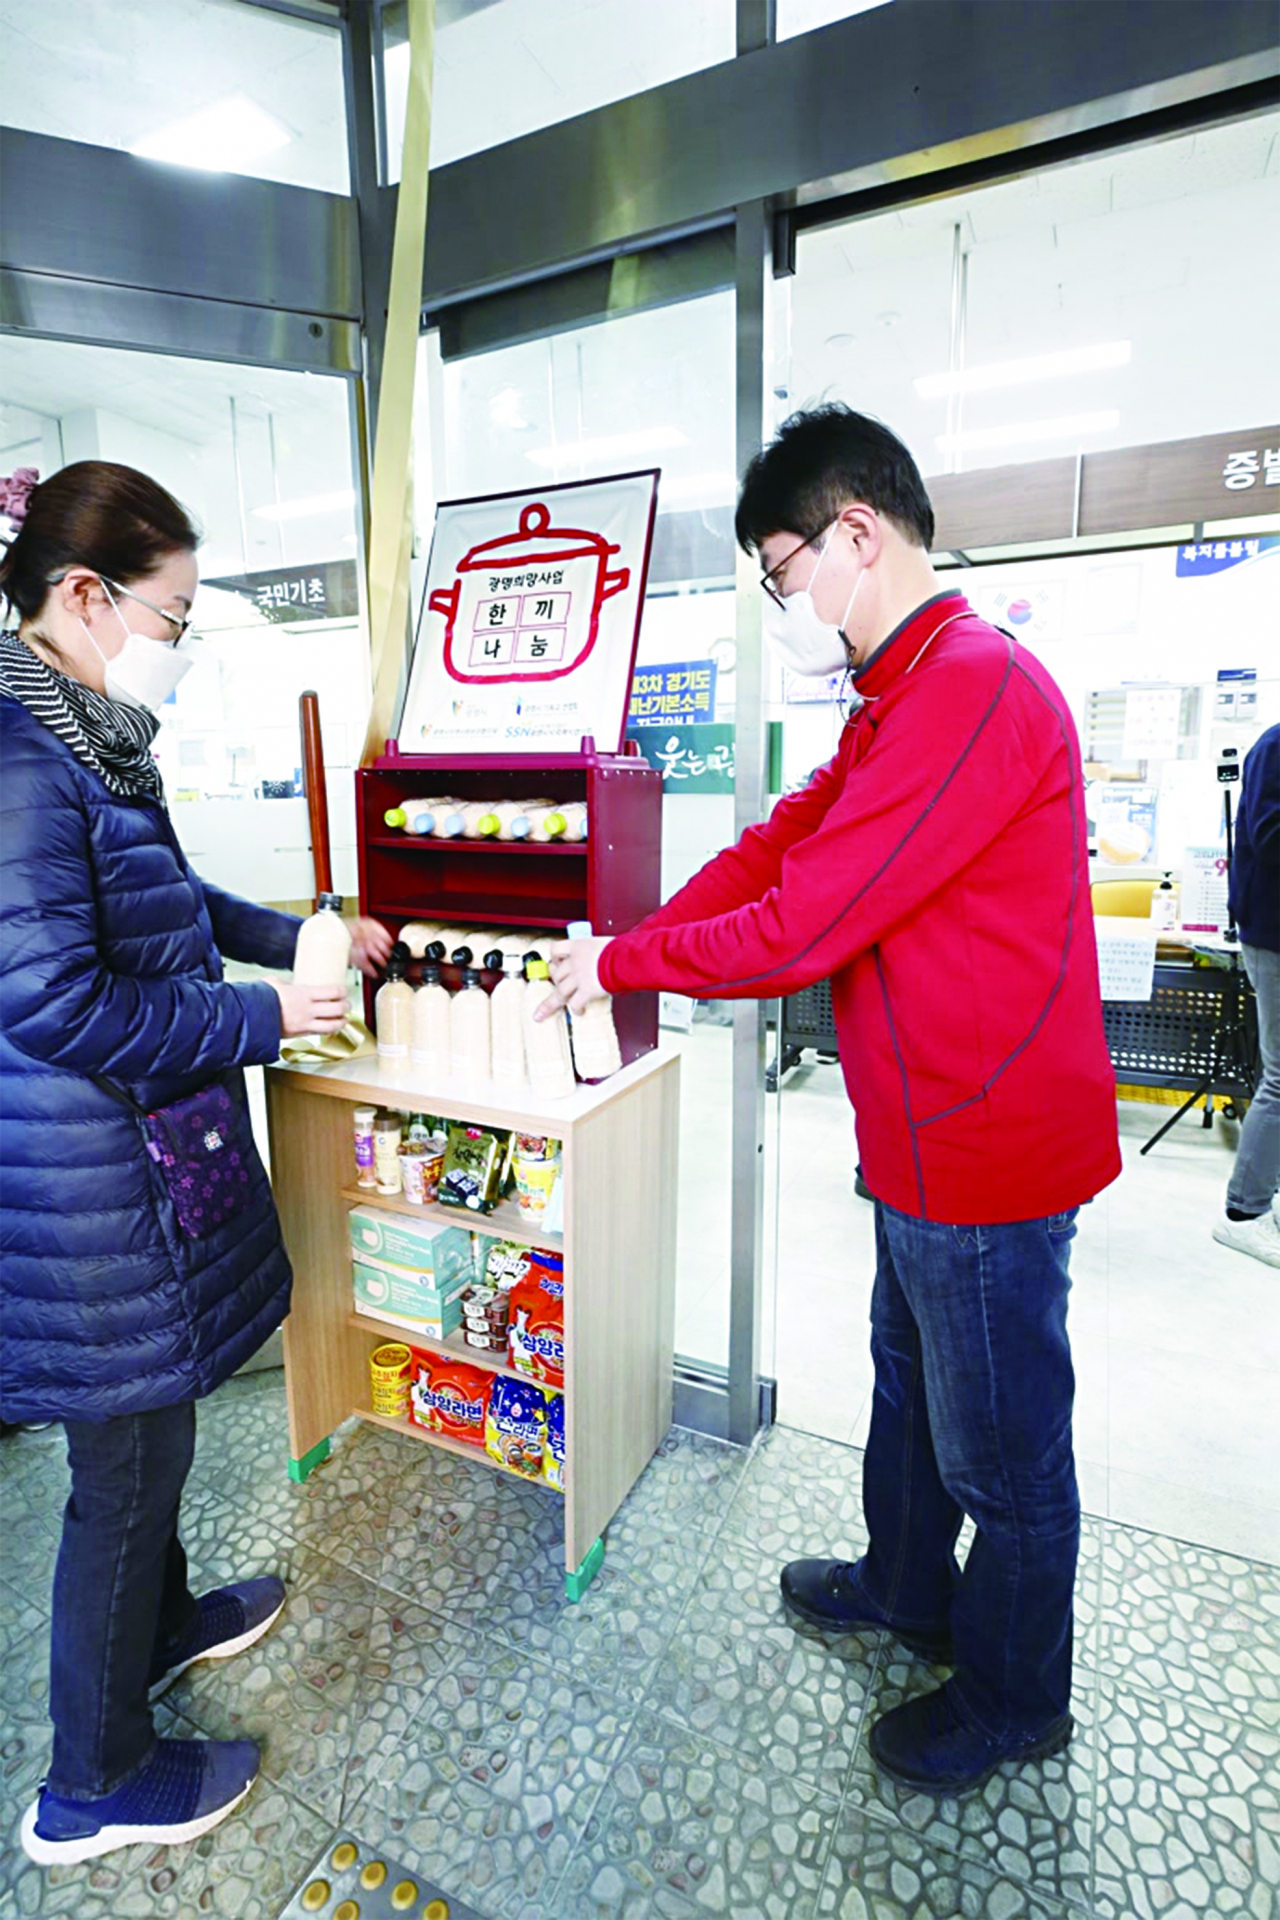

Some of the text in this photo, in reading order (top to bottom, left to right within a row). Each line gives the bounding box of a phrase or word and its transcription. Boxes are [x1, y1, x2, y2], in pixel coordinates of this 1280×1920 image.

[256, 577, 326, 609] 국민기초
[489, 570, 564, 592] 광명희망사업
[489, 599, 554, 626] 한 끼
[484, 635, 548, 658] 나 눔
[667, 670, 711, 692] 경기도
[505, 727, 531, 738] SSN
[655, 736, 706, 780] 웃는
[423, 1391, 483, 1420] 삼양라면
